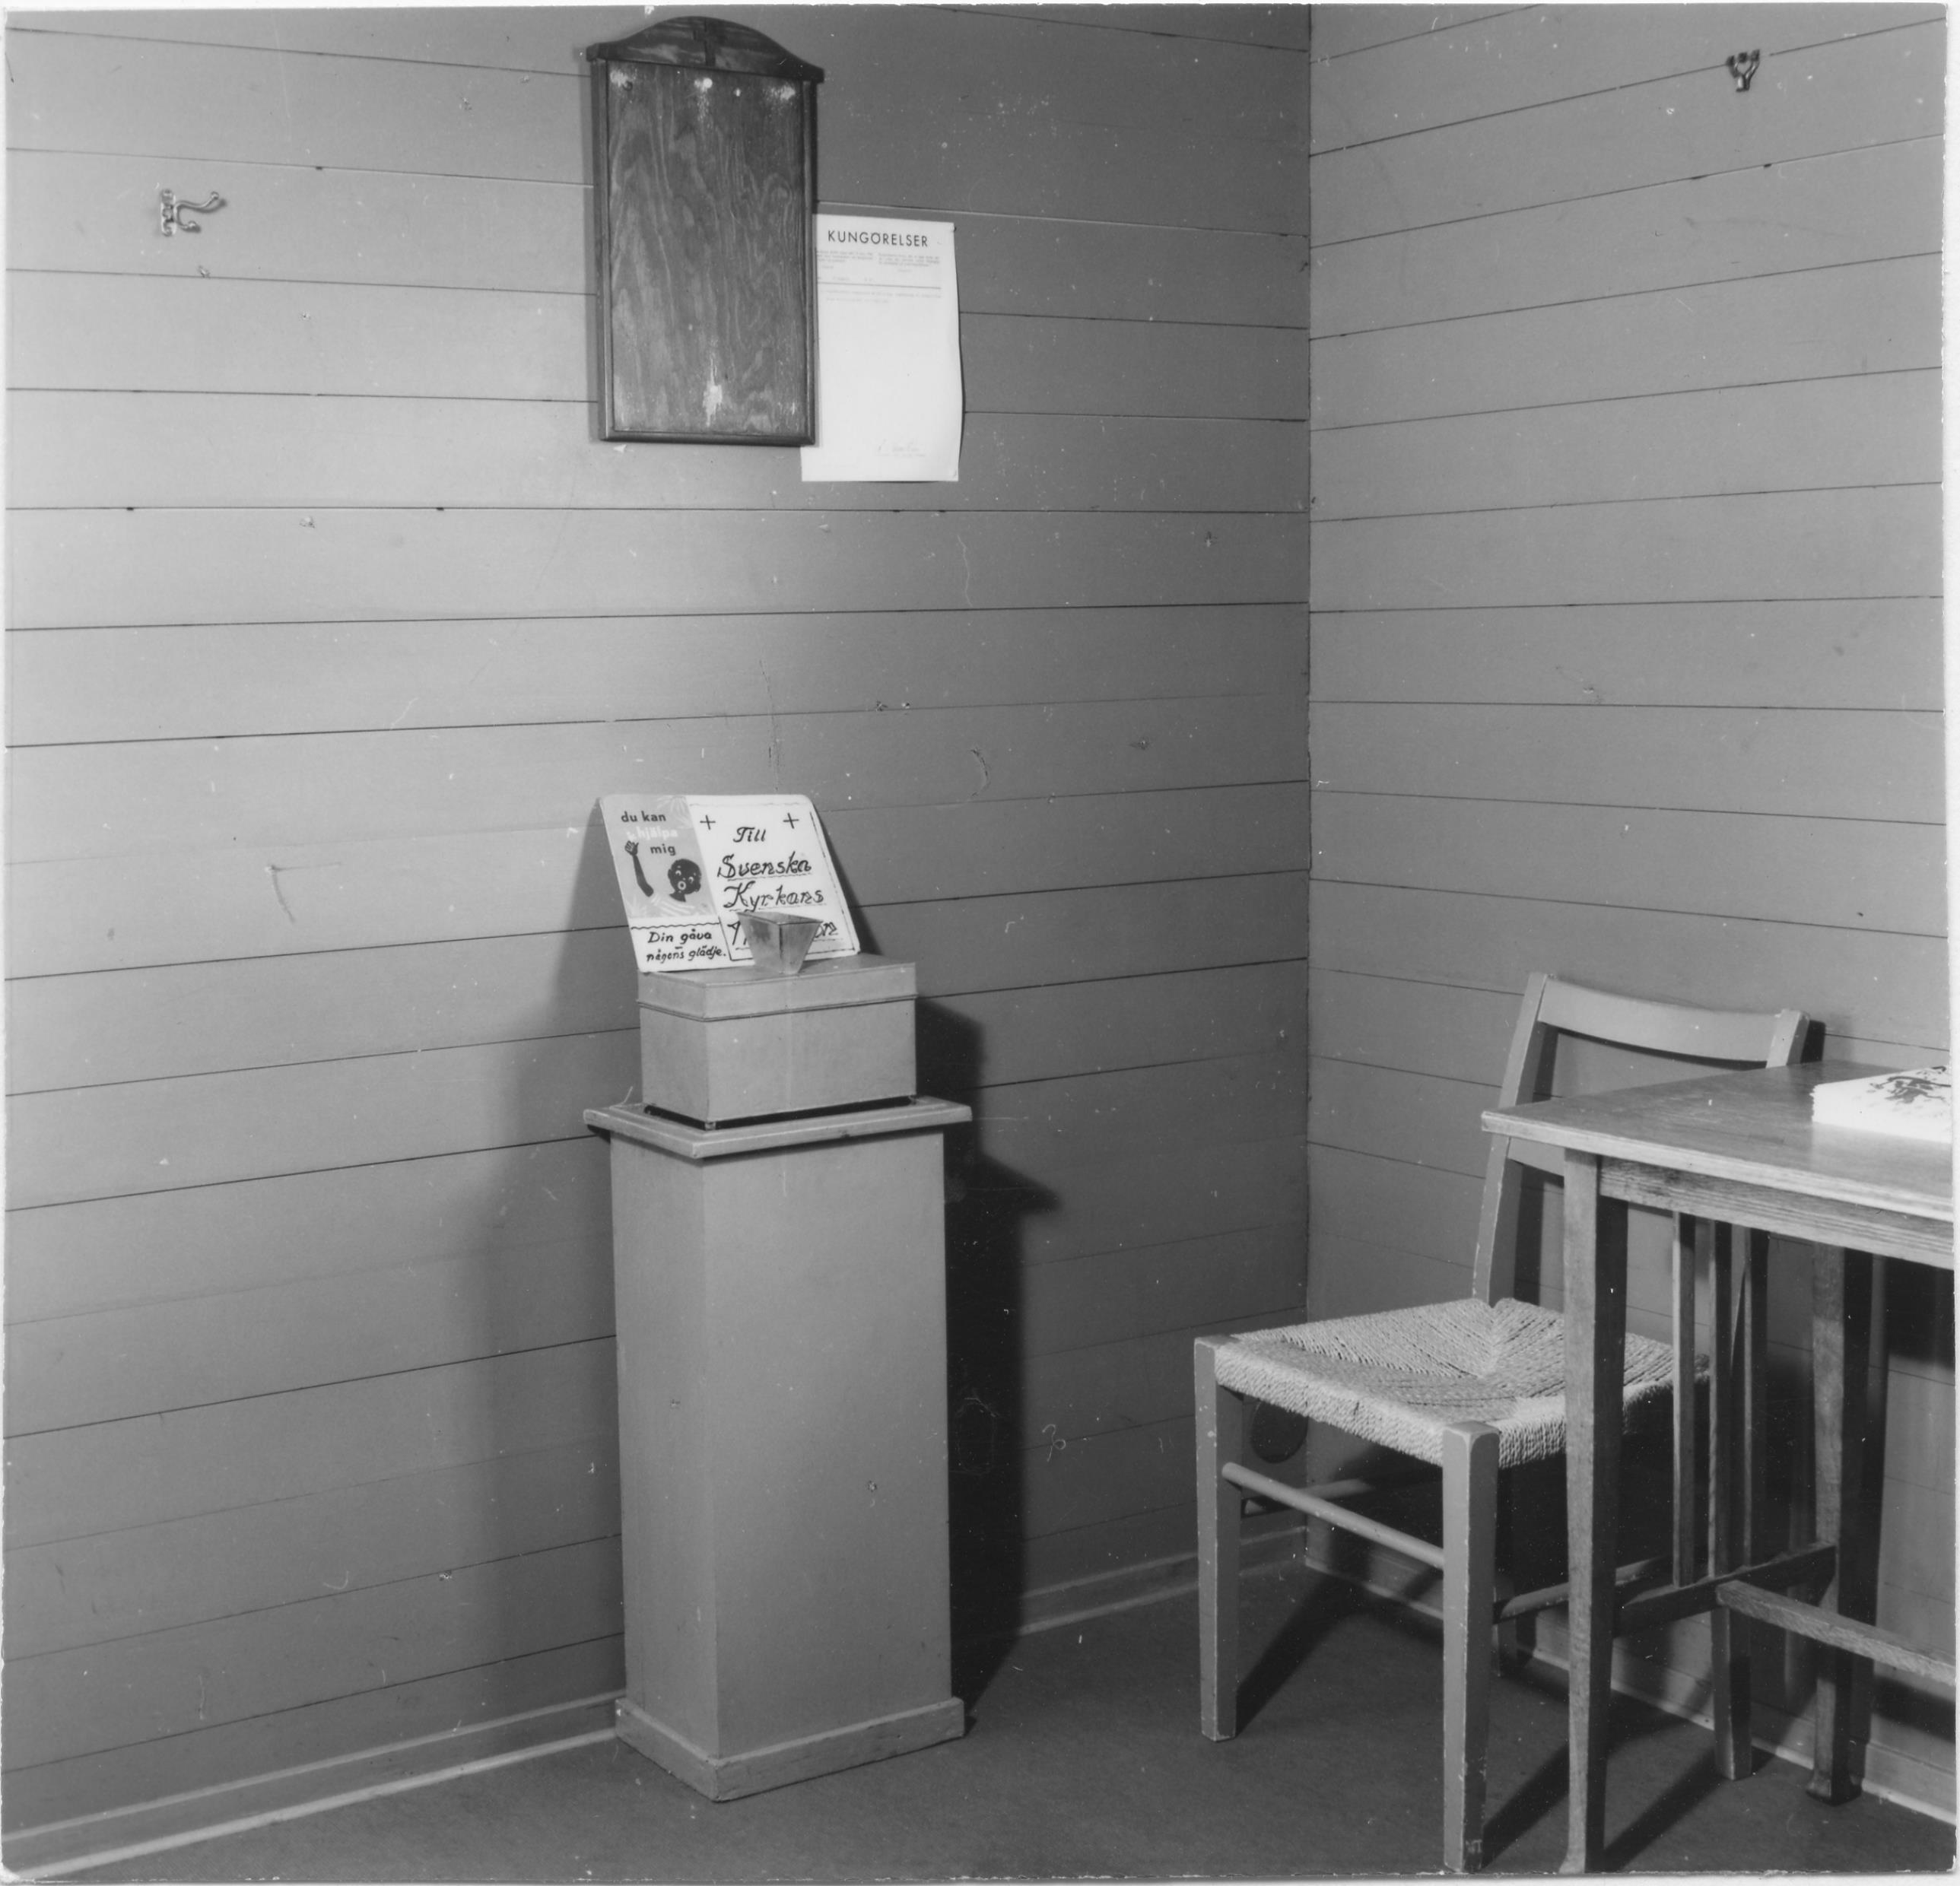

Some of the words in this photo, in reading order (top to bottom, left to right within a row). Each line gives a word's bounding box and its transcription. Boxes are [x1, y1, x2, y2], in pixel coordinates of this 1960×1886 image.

[828, 230, 928, 247] KUNGÖRELSER
[621, 810, 638, 823] du
[641, 810, 666, 822] kan
[636, 826, 678, 841] hjälpa
[732, 826, 767, 843] Till
[650, 843, 676, 856] mig
[716, 850, 812, 878] Svenska
[723, 880, 824, 913] Kyrkans
[647, 931, 674, 944] Din
[679, 928, 712, 945] gåva
[688, 945, 726, 962] glädje.
